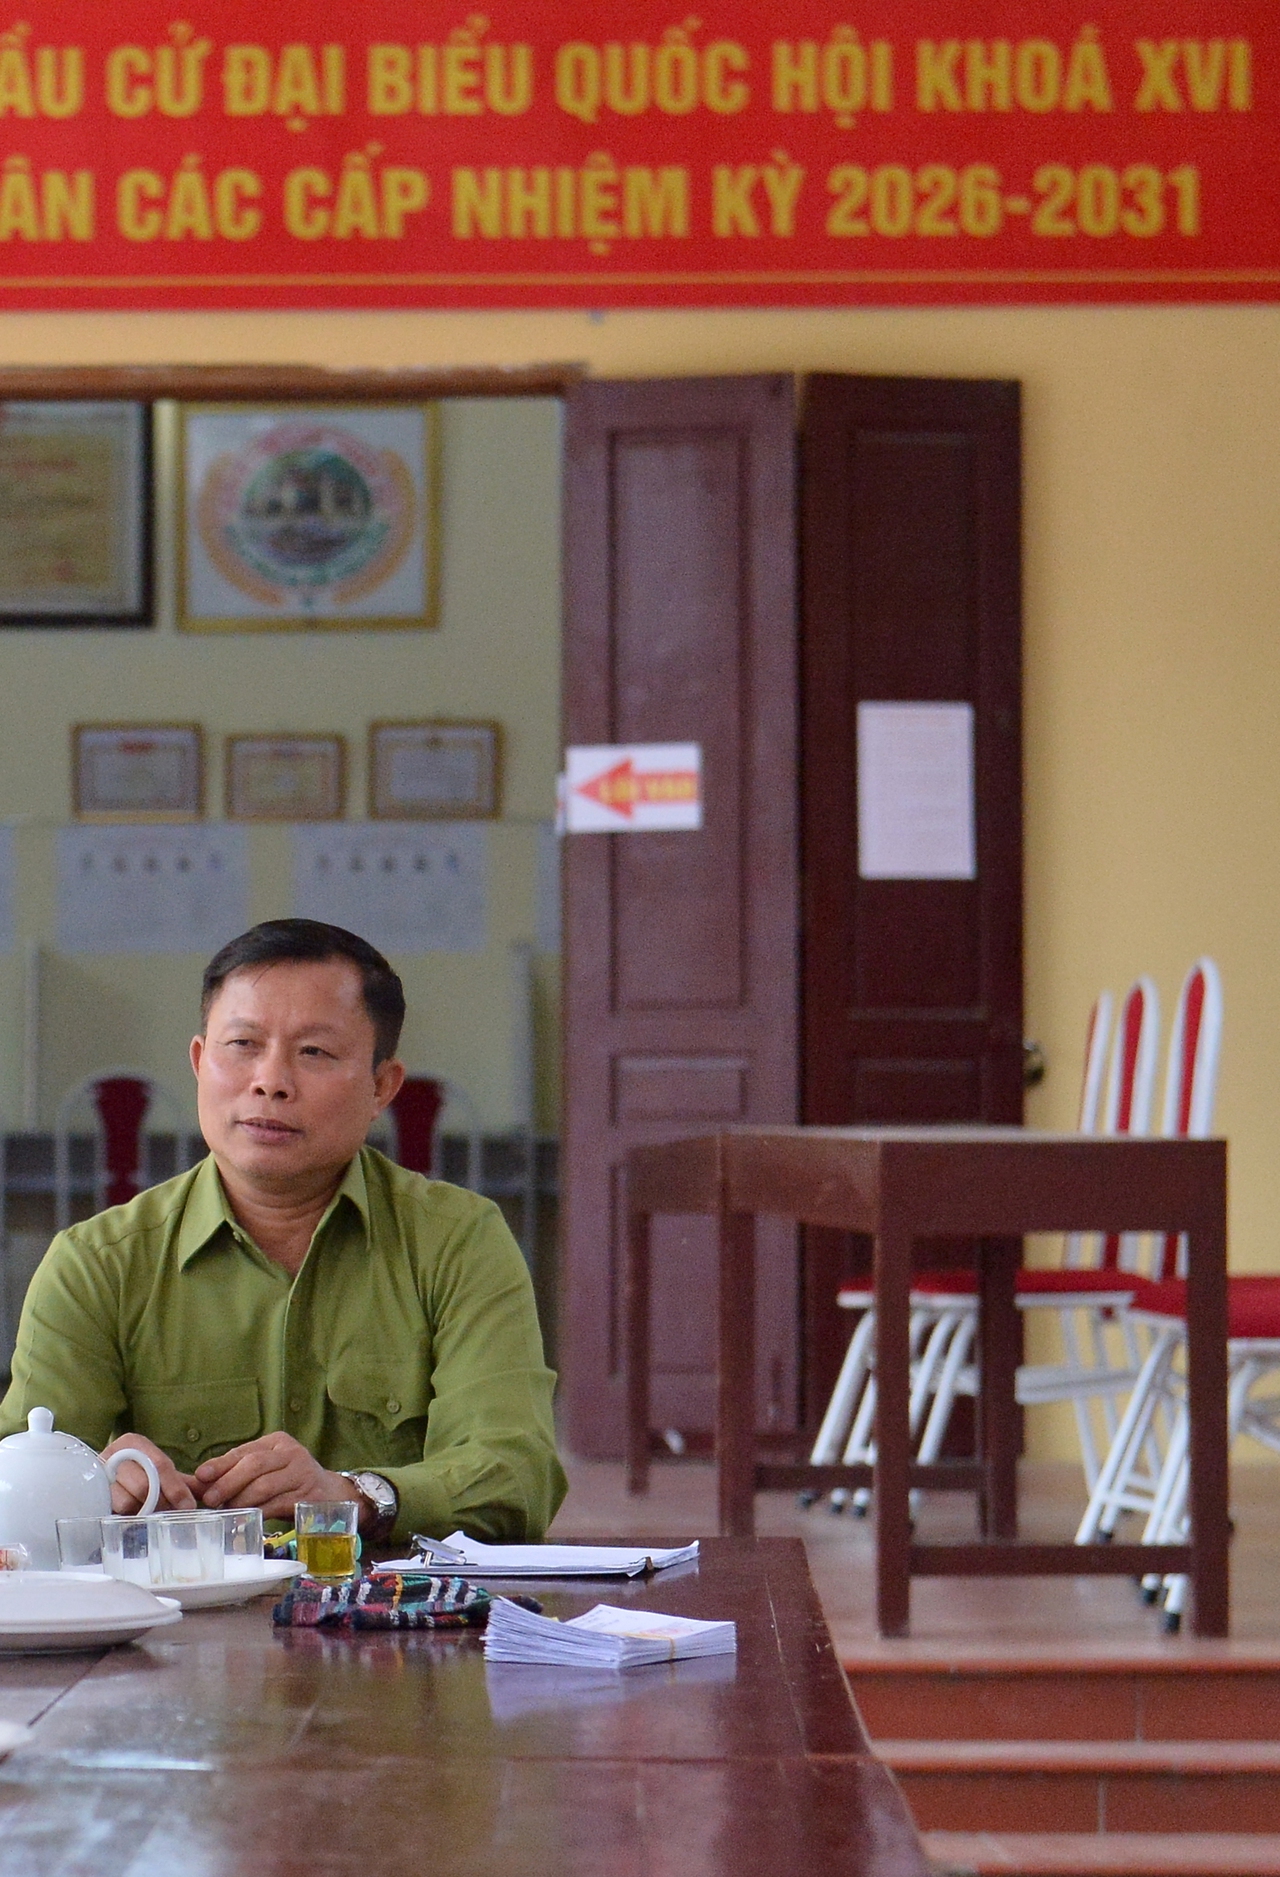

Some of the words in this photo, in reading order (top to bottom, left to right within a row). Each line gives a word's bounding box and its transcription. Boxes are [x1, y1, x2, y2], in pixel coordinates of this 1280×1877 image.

[106, 20, 212, 118] CỬ
[222, 44, 345, 132] ĐẠI
[368, 15, 532, 116] BIỂU
[555, 15, 749, 122] QUỐC
[772, 25, 892, 129] HỘI
[917, 23, 1111, 112] KHOÁ
[1135, 38, 1251, 112] XVI
[116, 154, 262, 240] CÁC
[283, 141, 430, 240] CẤP
[451, 150, 689, 256] NHIỆM
[712, 149, 804, 238] KỲ
[826, 164, 1202, 238] 2026-2031
